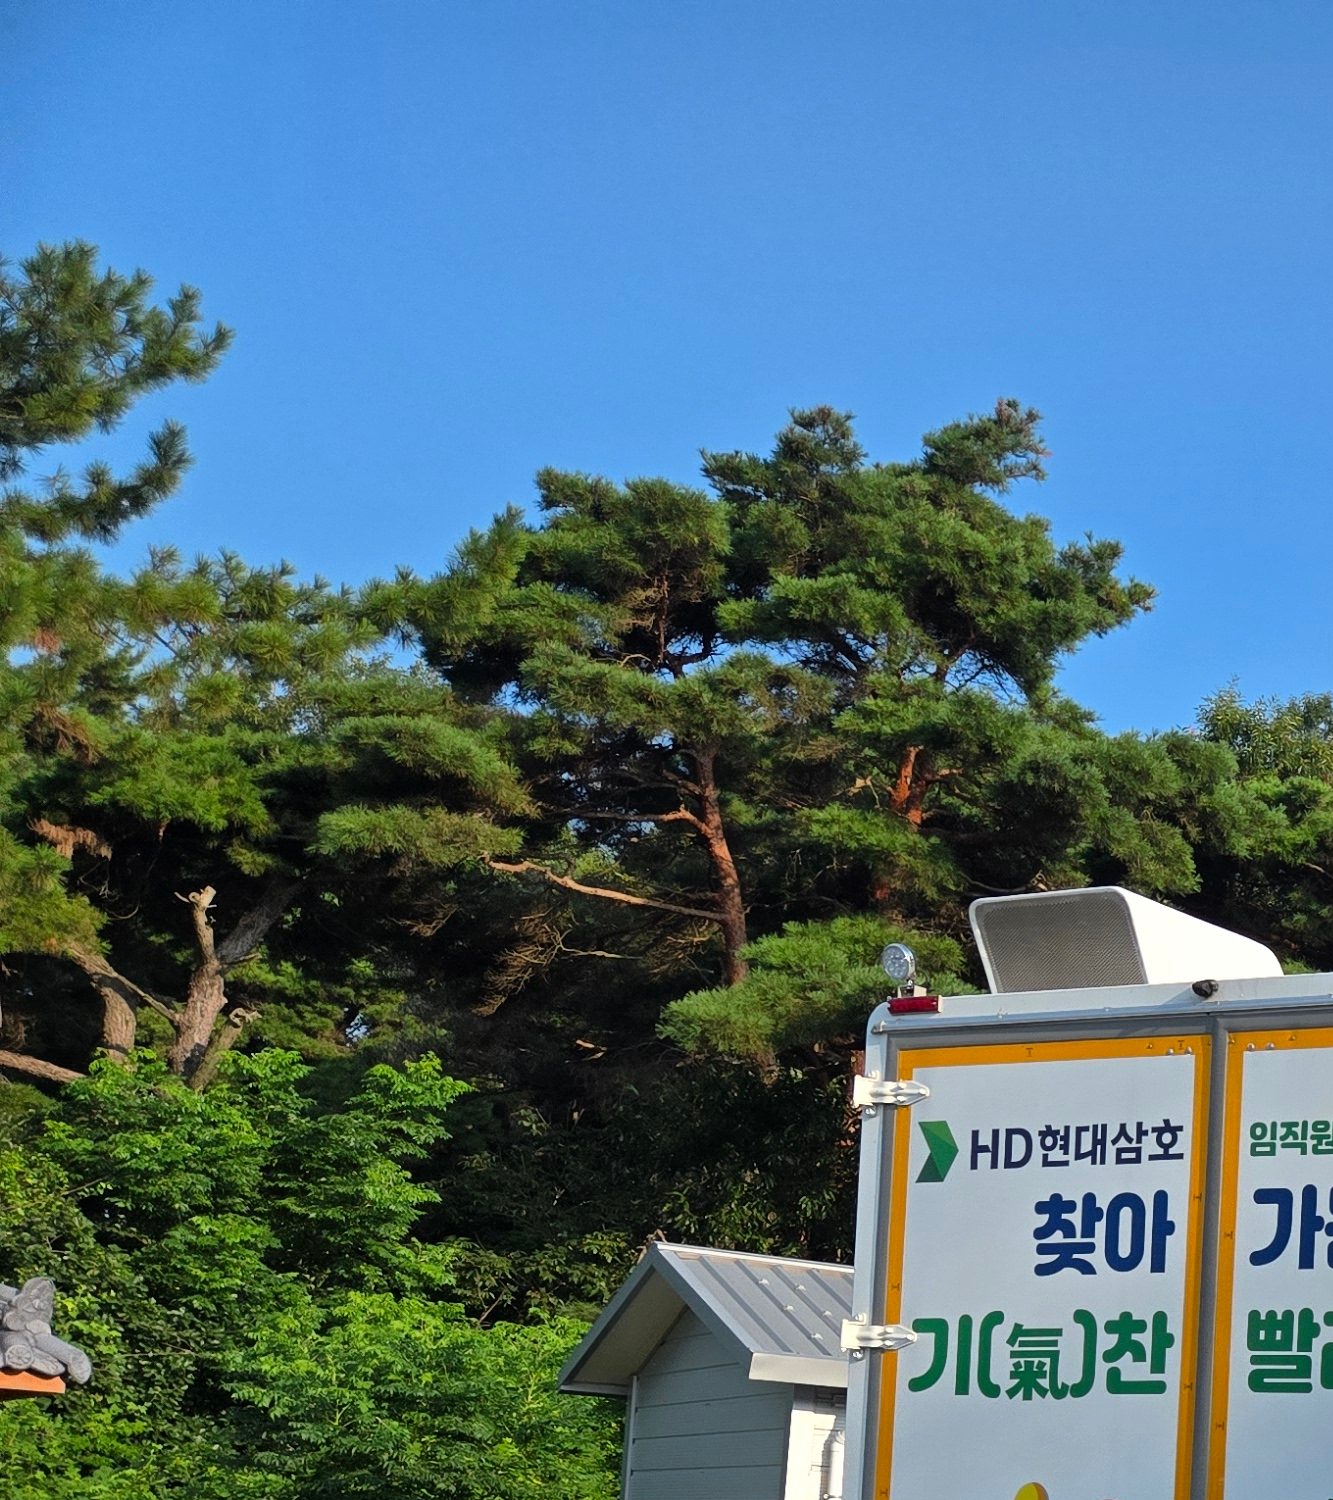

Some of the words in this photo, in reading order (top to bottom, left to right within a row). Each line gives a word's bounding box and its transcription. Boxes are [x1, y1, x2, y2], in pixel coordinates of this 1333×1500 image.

[970, 1119, 1185, 1171] HD현대삼호
[1032, 1189, 1176, 1277] 찾아
[908, 1309, 1176, 1401] 기(氣)찬
